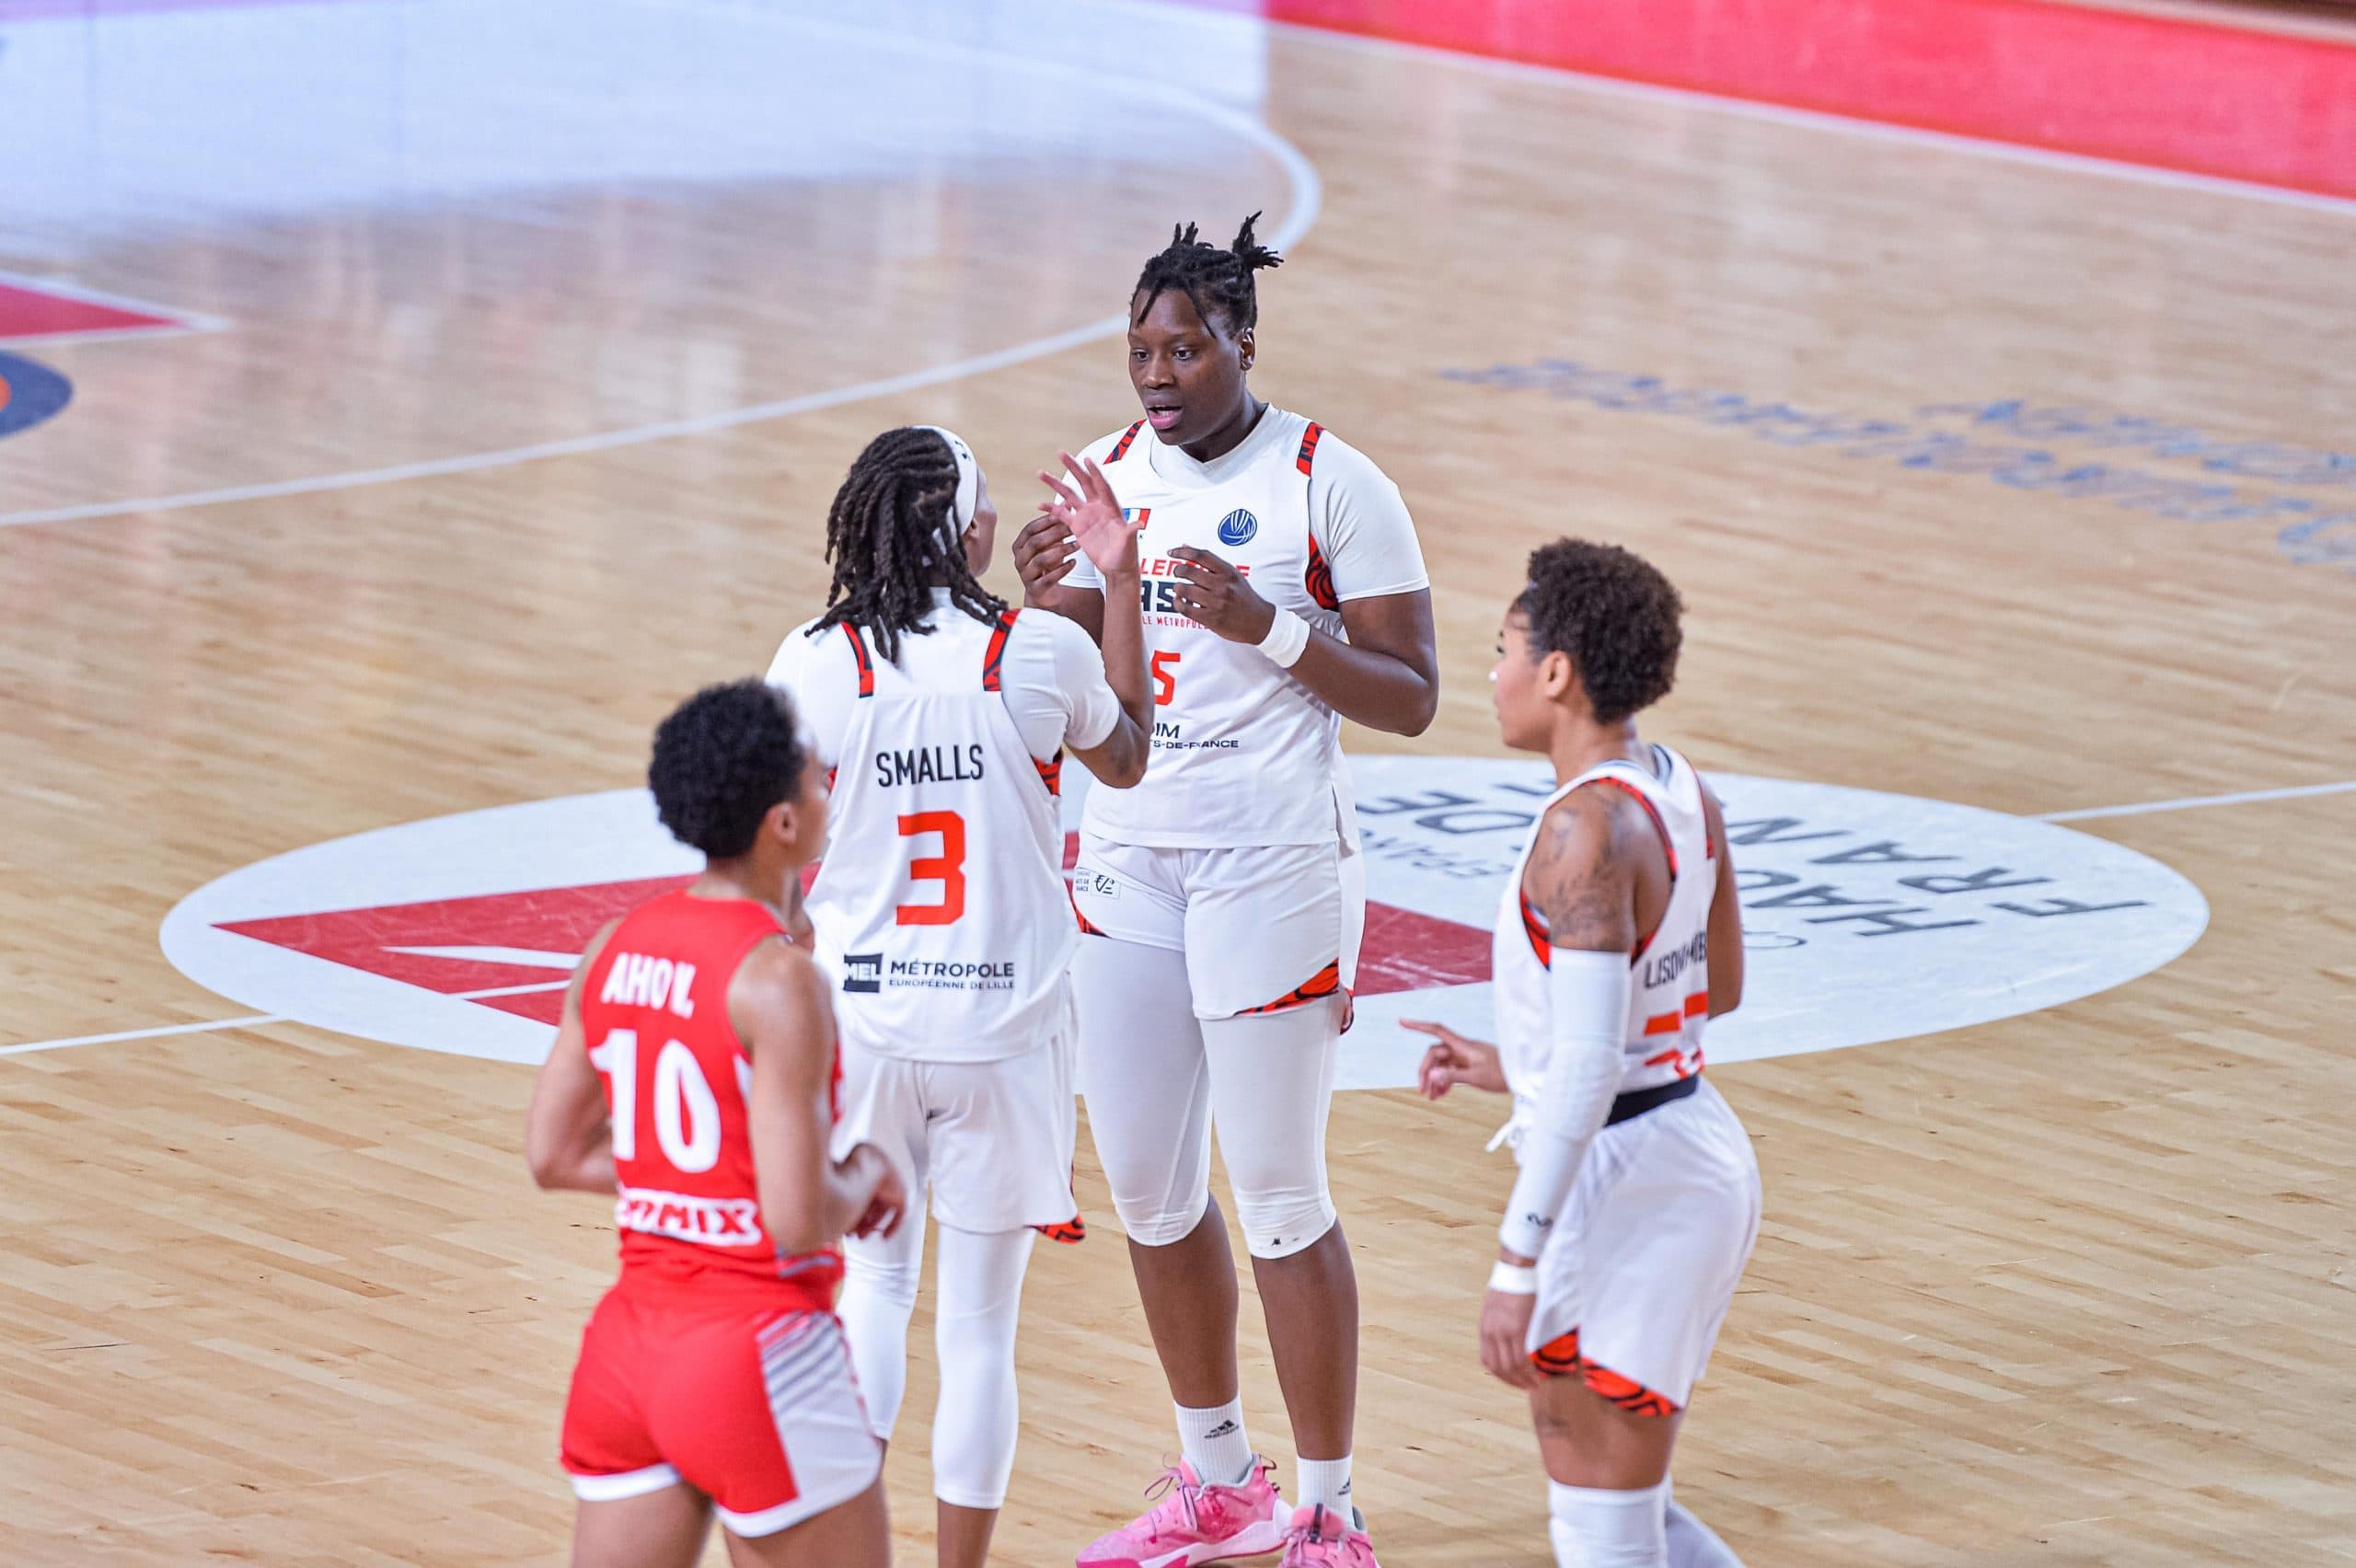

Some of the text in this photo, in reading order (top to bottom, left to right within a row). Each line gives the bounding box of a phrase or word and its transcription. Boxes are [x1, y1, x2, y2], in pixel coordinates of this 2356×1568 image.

[875, 744, 984, 788] SMALLS
[896, 810, 965, 926] 3
[889, 979, 964, 989] EUROPÉENNE
[970, 981, 983, 989] DE
[890, 959, 1014, 977] MÉTROPOLE
[589, 1029, 722, 1173] 10
